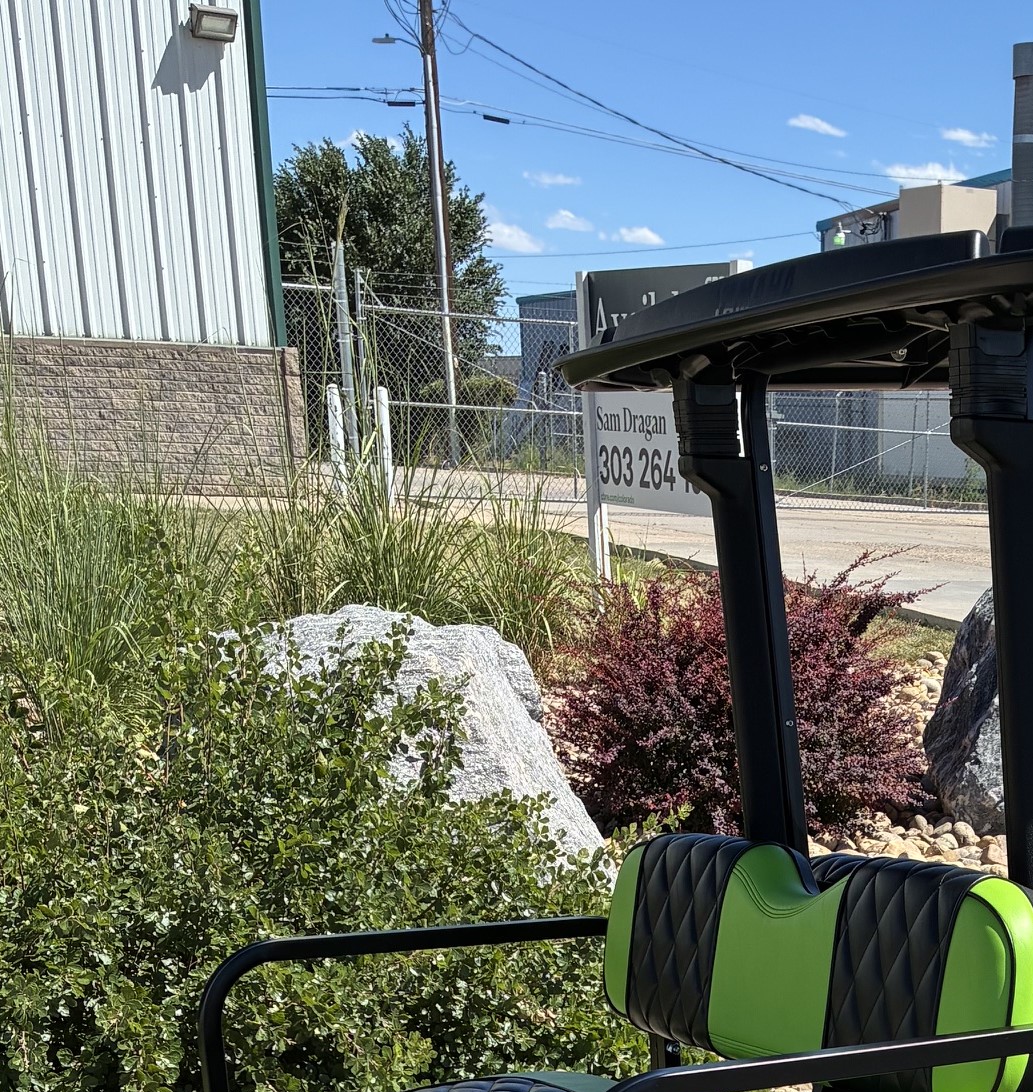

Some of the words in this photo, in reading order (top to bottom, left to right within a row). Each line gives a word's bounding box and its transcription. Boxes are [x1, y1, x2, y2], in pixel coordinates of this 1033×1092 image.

[596, 405, 621, 432] Sam
[622, 407, 667, 442] Dragan
[599, 444, 634, 488] 303
[638, 447, 676, 492] 264
